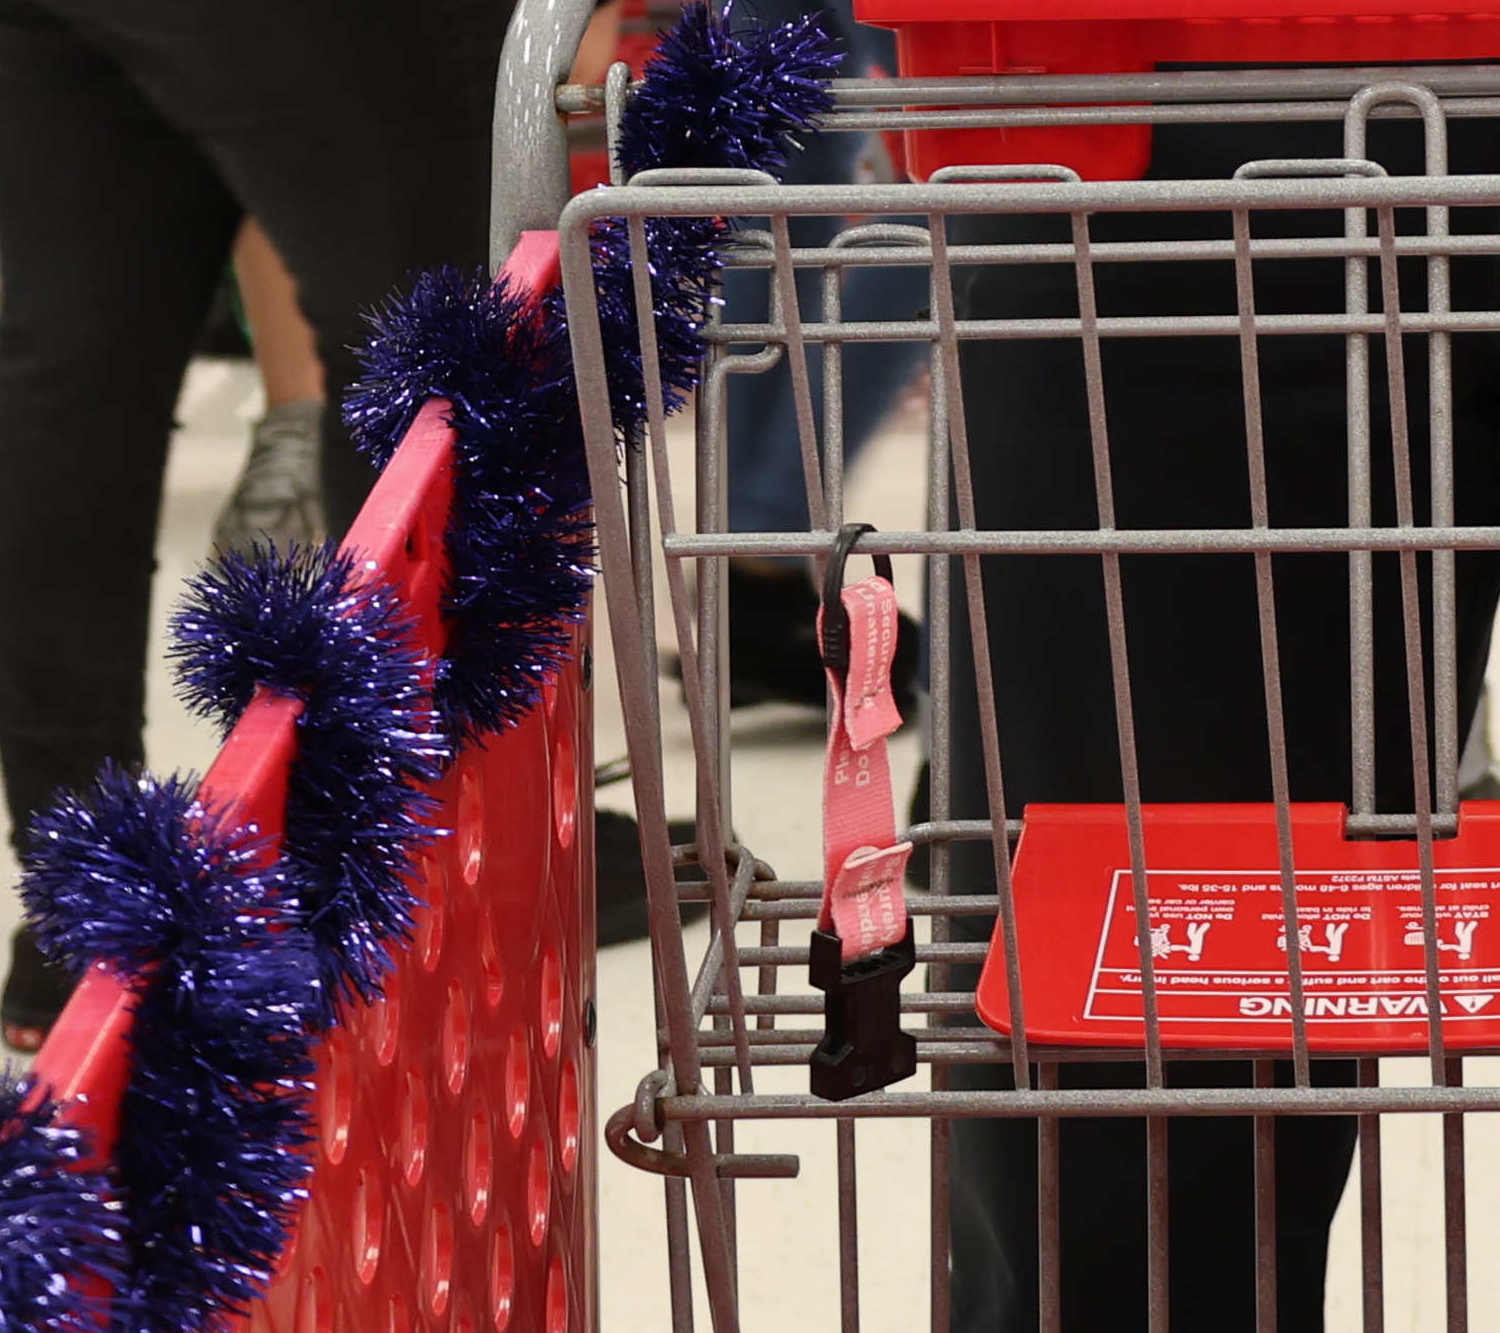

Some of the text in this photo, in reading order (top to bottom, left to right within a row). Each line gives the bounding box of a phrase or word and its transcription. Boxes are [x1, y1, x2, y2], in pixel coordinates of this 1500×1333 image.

[1178, 884, 1199, 892] lbs.
[1352, 883, 1383, 891] ages
[1439, 883, 1457, 891] for
[1460, 882, 1487, 890] seat
[880, 856, 901, 942] Seurely
[1119, 974, 1167, 984] inry.
[1170, 976, 1209, 985] head
[1213, 977, 1271, 985] serious
[1288, 977, 1333, 985] suff
[1337, 977, 1367, 985] and
[1370, 977, 1400, 985] cart
[1453, 975, 1479, 983] out
[1240, 997, 1448, 1015] WARNING
